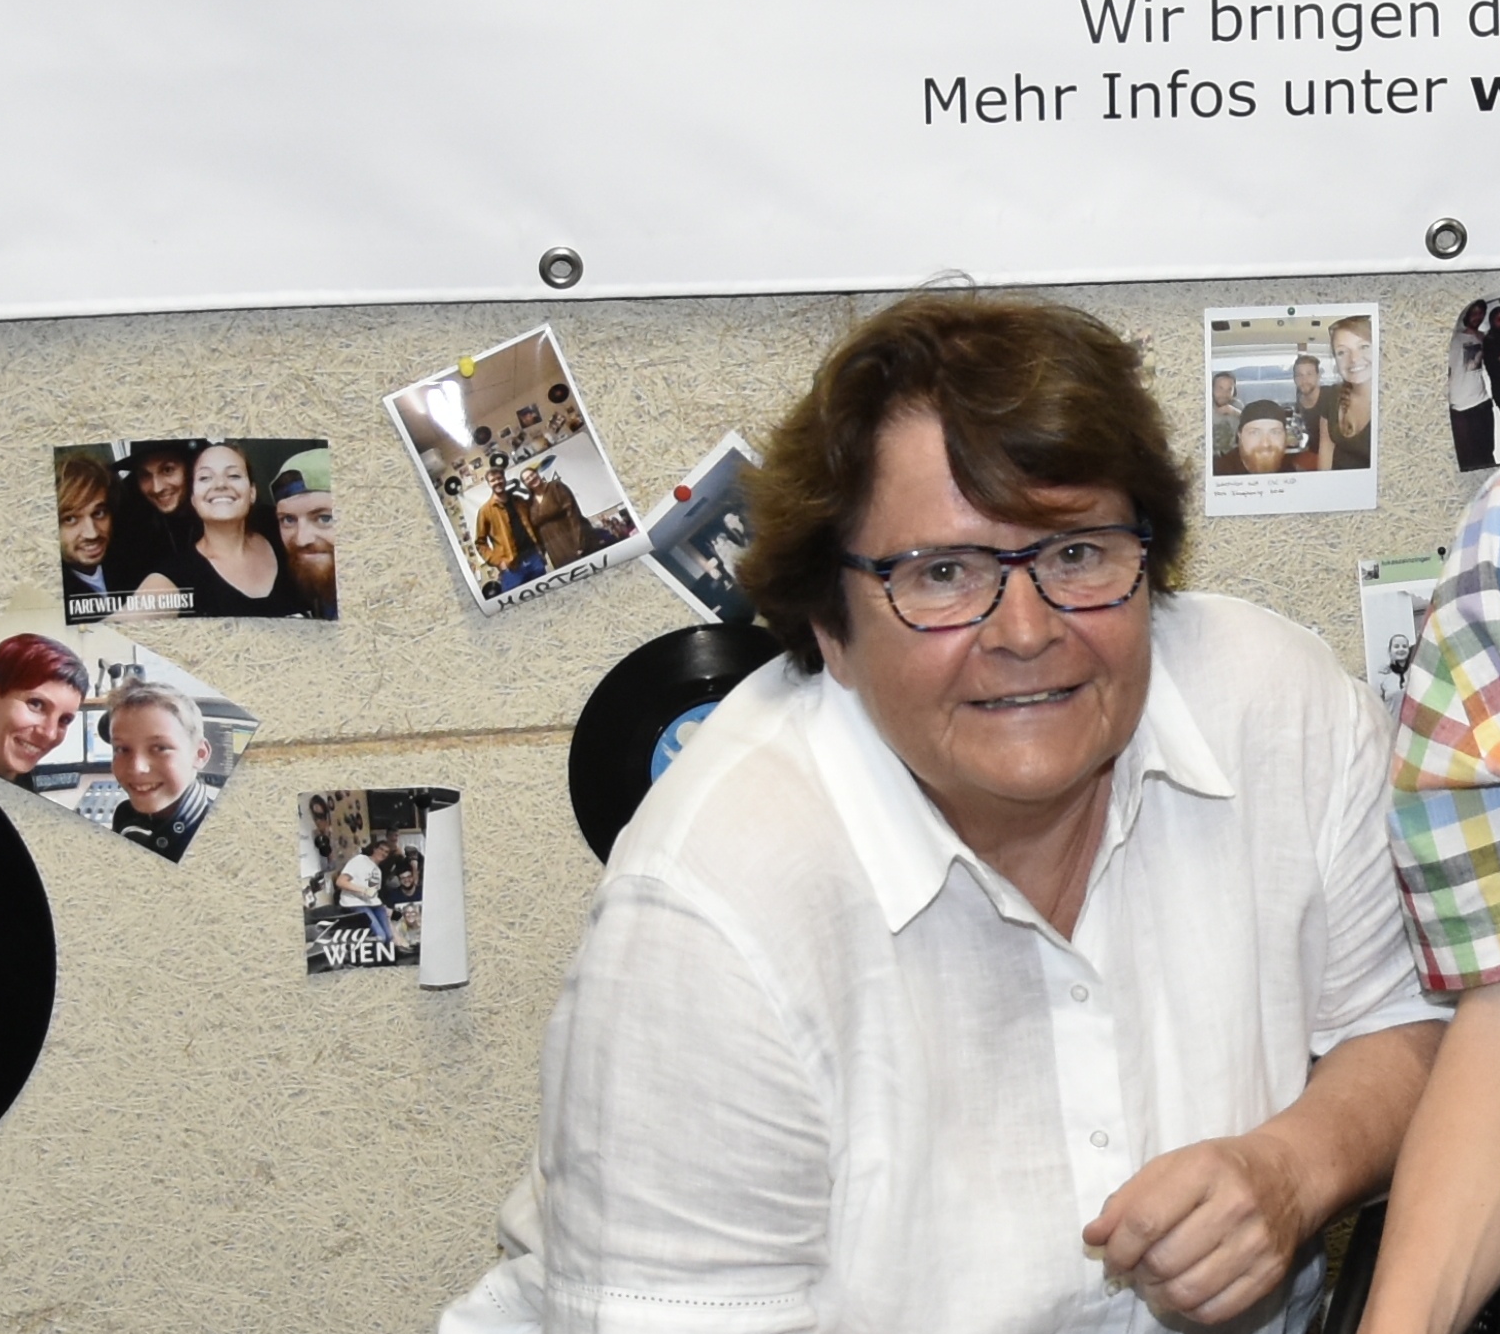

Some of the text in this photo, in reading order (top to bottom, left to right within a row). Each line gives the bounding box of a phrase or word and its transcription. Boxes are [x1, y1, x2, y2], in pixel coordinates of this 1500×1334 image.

[924, 73, 1077, 125] Mehr
[1102, 70, 1256, 120] Infos
[1285, 69, 1448, 116] unter
[69, 592, 195, 616] FAREWELL DEAR GHOST
[323, 941, 396, 965] WIEN
